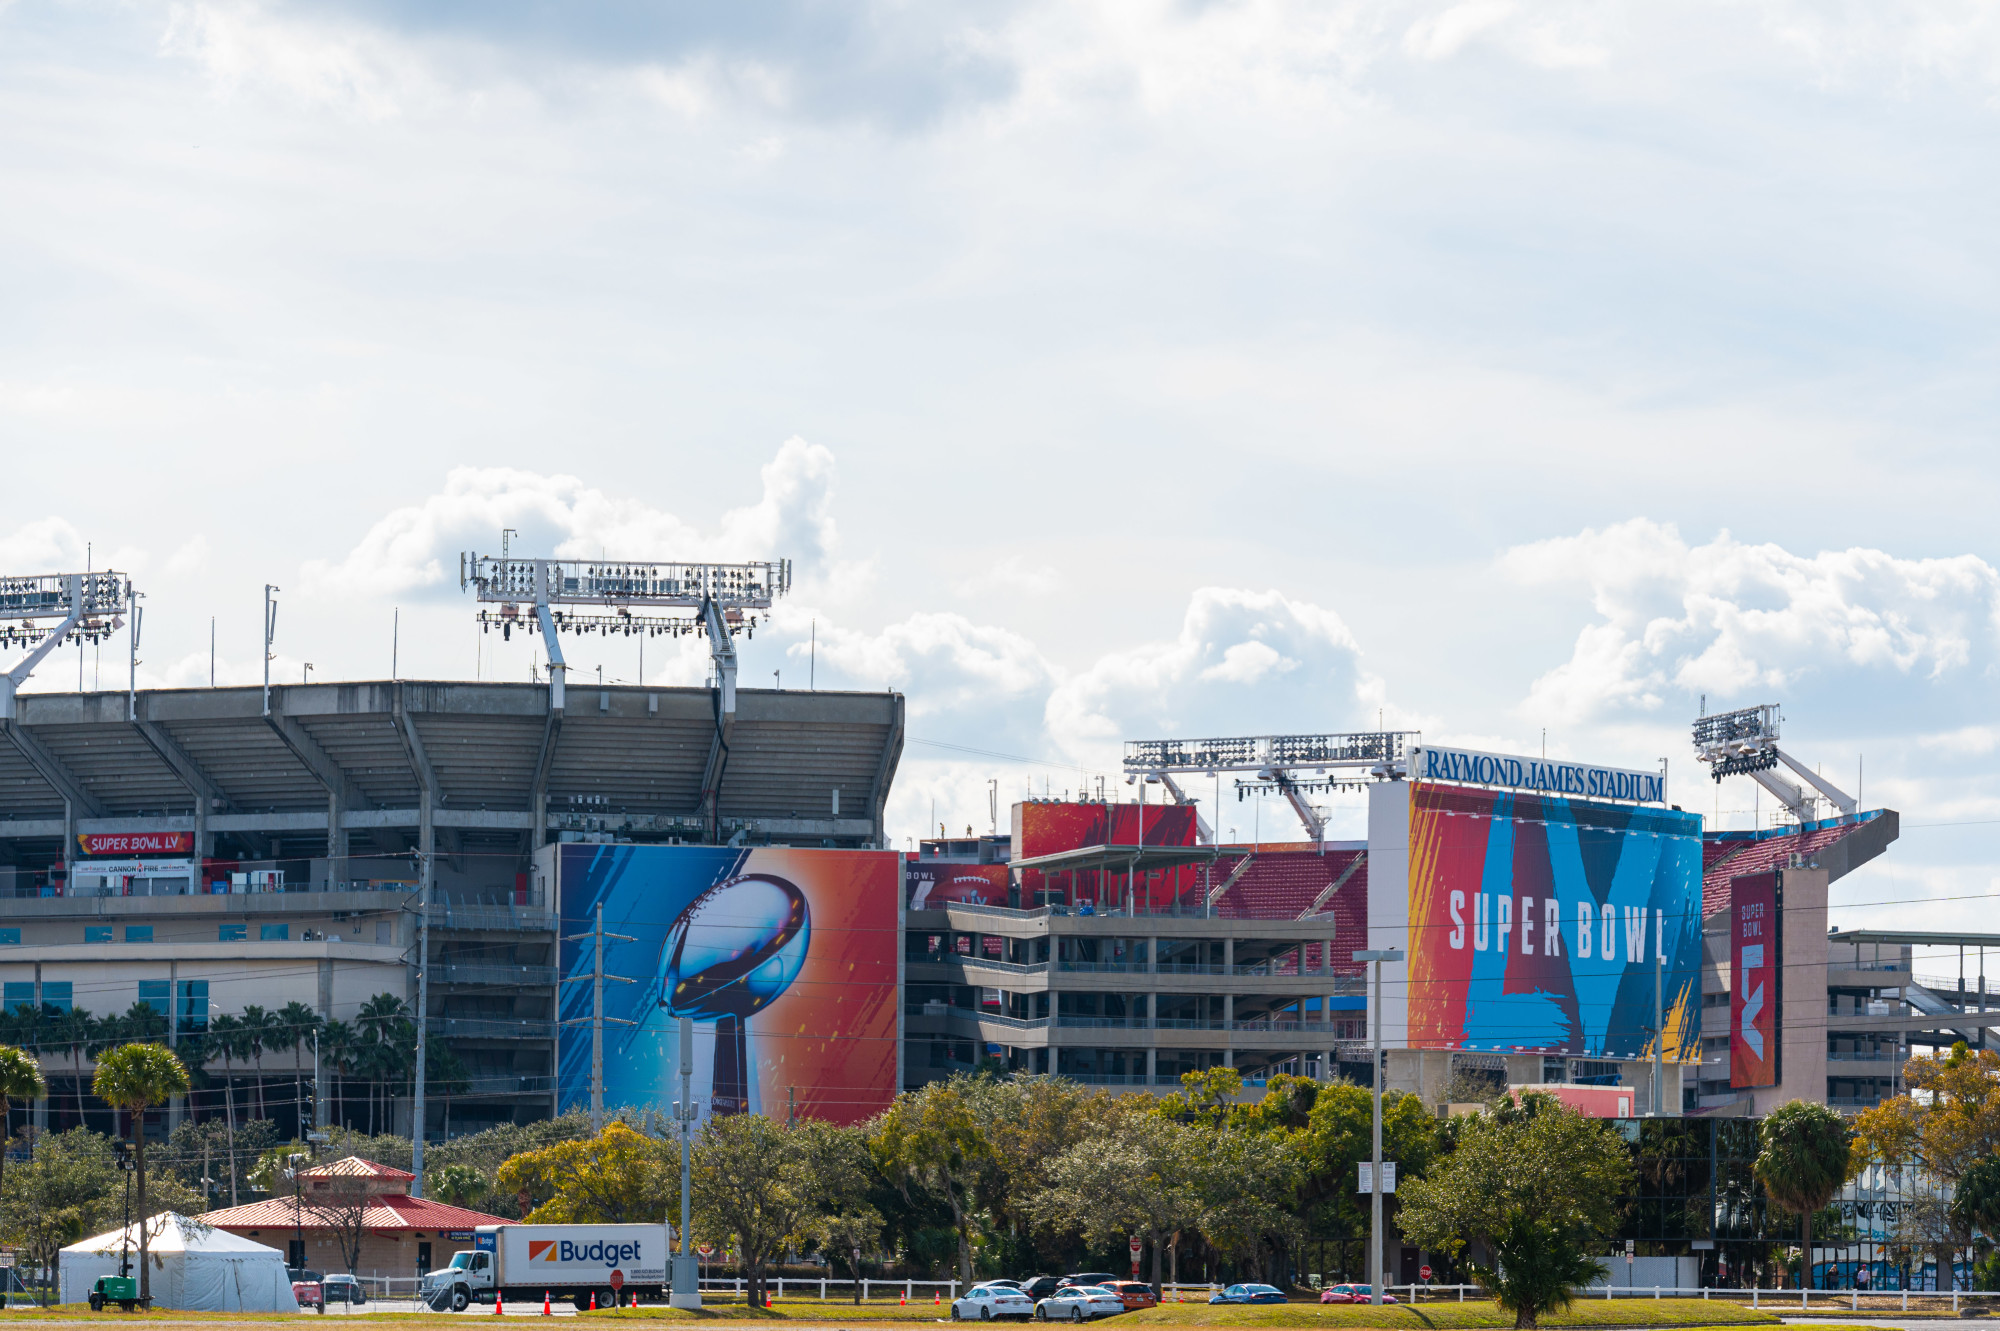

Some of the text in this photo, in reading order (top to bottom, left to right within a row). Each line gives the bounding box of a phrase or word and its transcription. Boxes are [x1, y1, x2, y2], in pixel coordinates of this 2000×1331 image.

[1426, 750, 1664, 803] RAYMOND JAMES STADIUM
[91, 836, 178, 851] SUPER BOWL LV
[108, 865, 137, 873] CANNON
[906, 871, 936, 880] BOWL
[1741, 903, 1764, 920] SUPER
[1449, 889, 1667, 965] SUPER BOWL
[1743, 920, 1763, 937] BOWL
[560, 1239, 641, 1268] Budget
[611, 1275, 623, 1284] STOP
